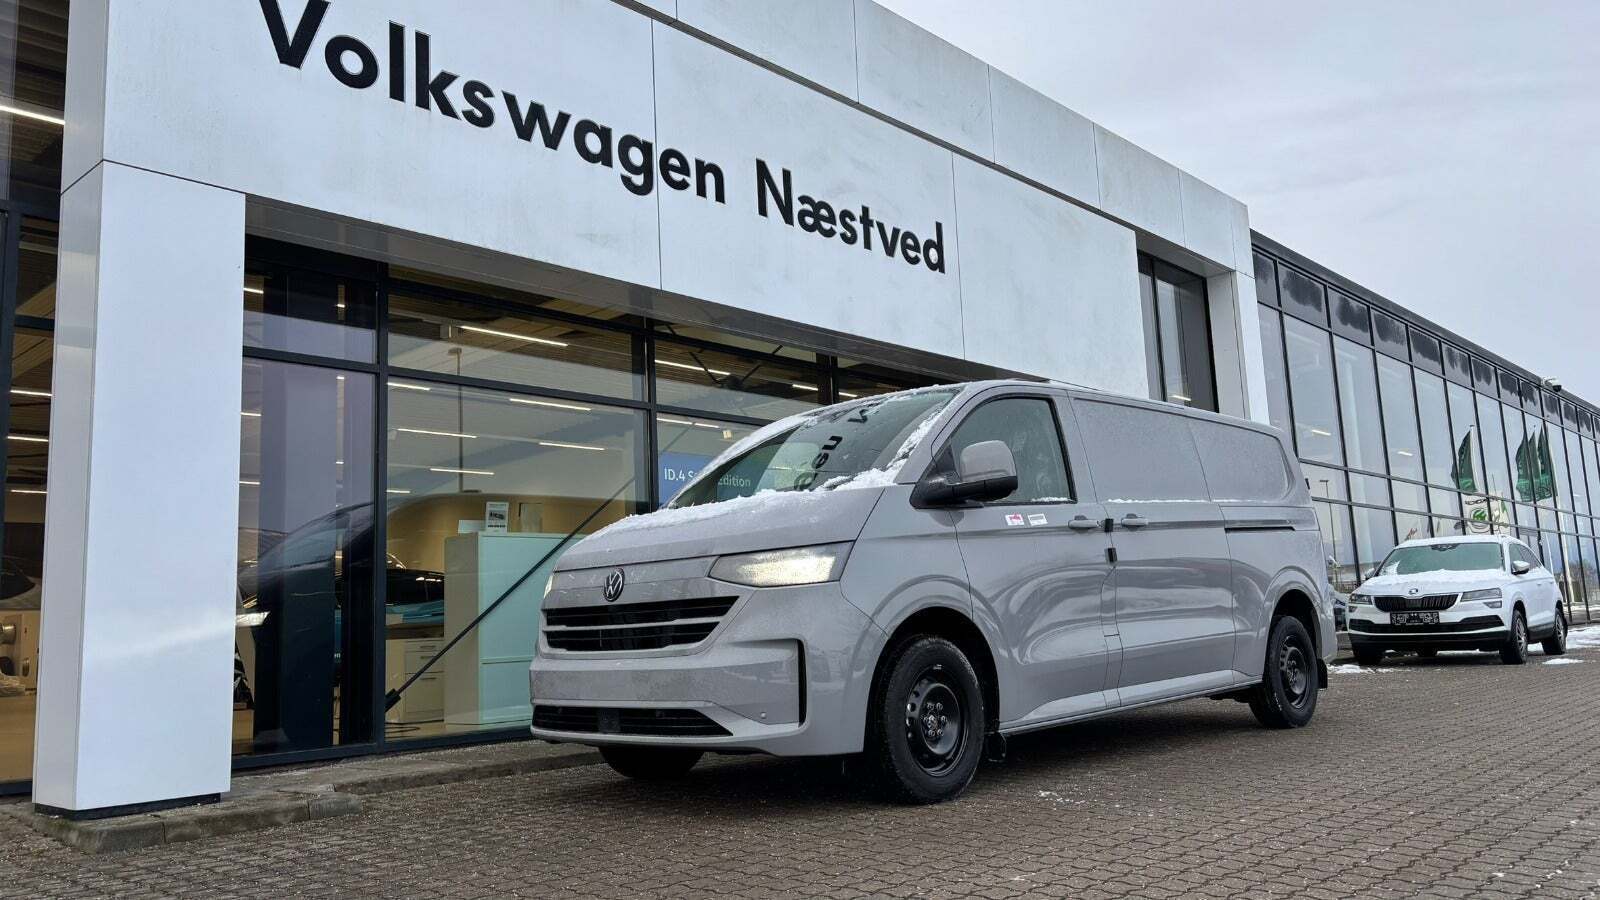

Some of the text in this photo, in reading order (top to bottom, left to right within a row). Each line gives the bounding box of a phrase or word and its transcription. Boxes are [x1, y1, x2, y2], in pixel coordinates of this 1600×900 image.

[259, 0, 946, 274] Volkswagen Næstved
[663, 466, 686, 482] ID.4
